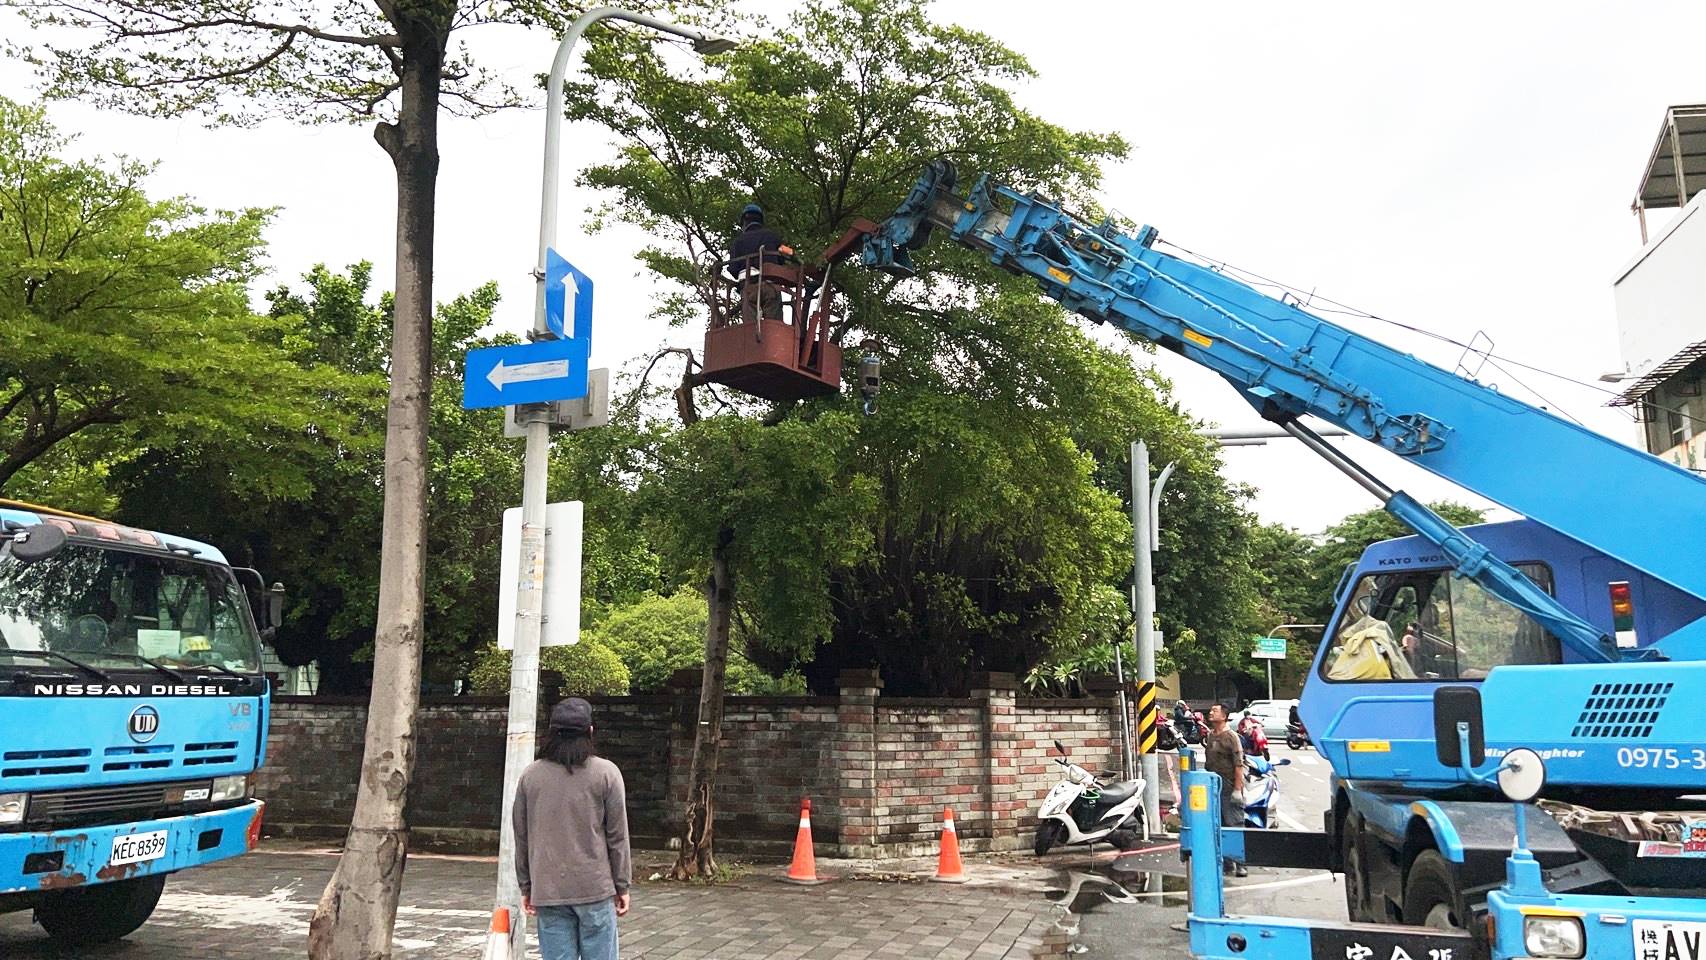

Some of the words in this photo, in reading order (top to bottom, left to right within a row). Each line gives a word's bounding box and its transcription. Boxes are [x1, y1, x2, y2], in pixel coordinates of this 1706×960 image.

[1379, 557, 1411, 566] KATO
[34, 684, 141, 695] NISSAN
[152, 685, 231, 695] DIESEL
[134, 714, 157, 732] UD
[1617, 747, 1706, 770] 0975-3
